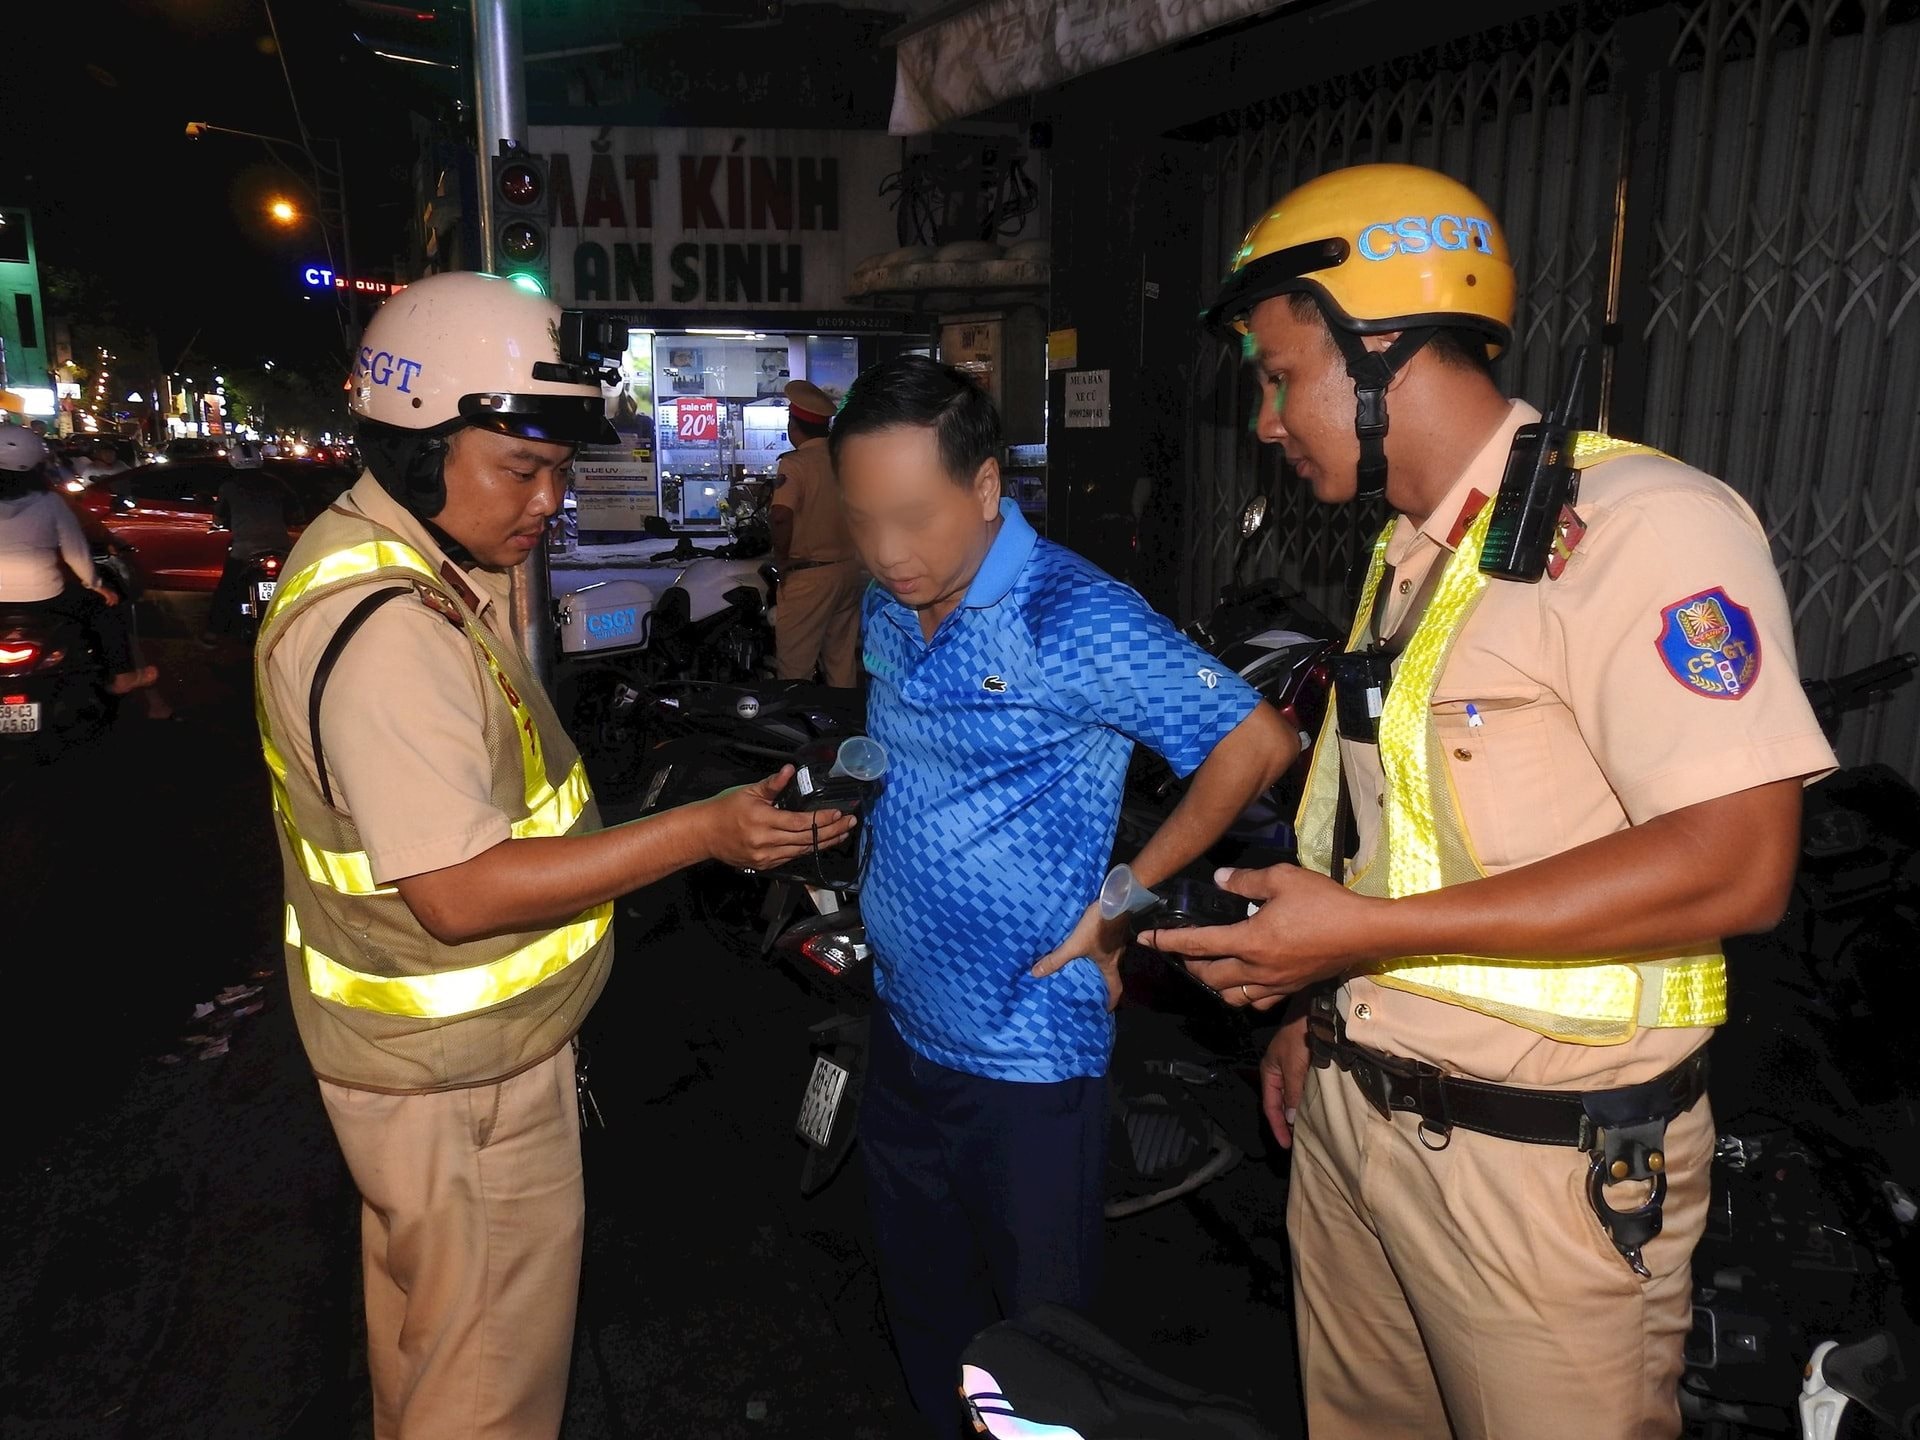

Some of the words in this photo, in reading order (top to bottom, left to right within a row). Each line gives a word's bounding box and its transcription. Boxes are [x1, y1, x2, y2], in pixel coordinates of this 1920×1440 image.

[679, 136, 839, 231] KÍNH
[1358, 214, 1493, 261] CSGT
[305, 268, 332, 286] CT
[574, 241, 654, 302] AN
[670, 241, 803, 303] SINH
[1070, 376, 1087, 385] MUA
[681, 403, 699, 411] sale
[700, 403, 713, 411] off
[680, 414, 716, 437] 20%
[586, 607, 637, 635] CSGT
[1688, 652, 1716, 674] CS
[1722, 640, 1747, 660] GT
[739, 703, 757, 711] GIVI
